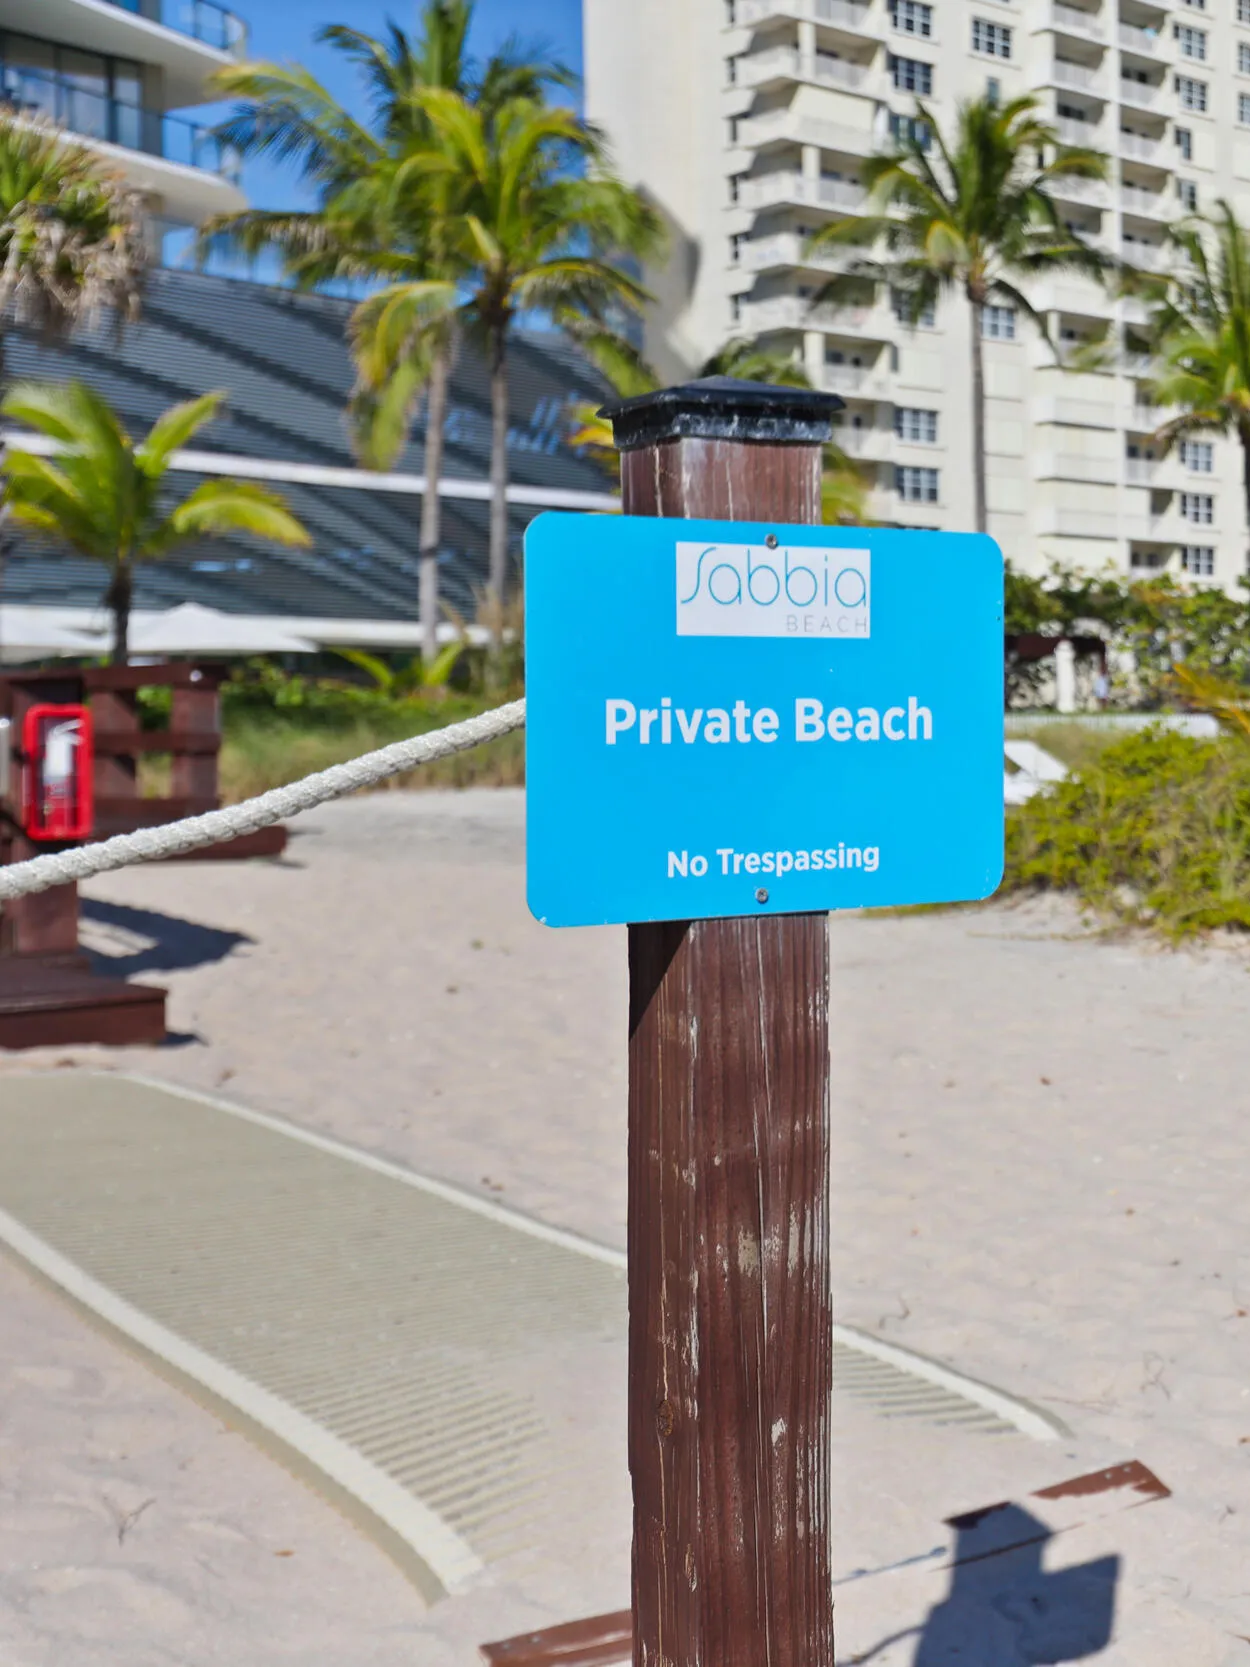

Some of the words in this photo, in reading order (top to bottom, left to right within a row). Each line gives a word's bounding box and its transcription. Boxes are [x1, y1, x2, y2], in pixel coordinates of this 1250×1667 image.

[681, 546, 867, 608] Sabbia
[785, 614, 867, 634] BEACH
[605, 697, 780, 745] Private
[795, 696, 933, 742] Beach
[667, 850, 709, 879] No
[716, 842, 880, 878] Trespassing
